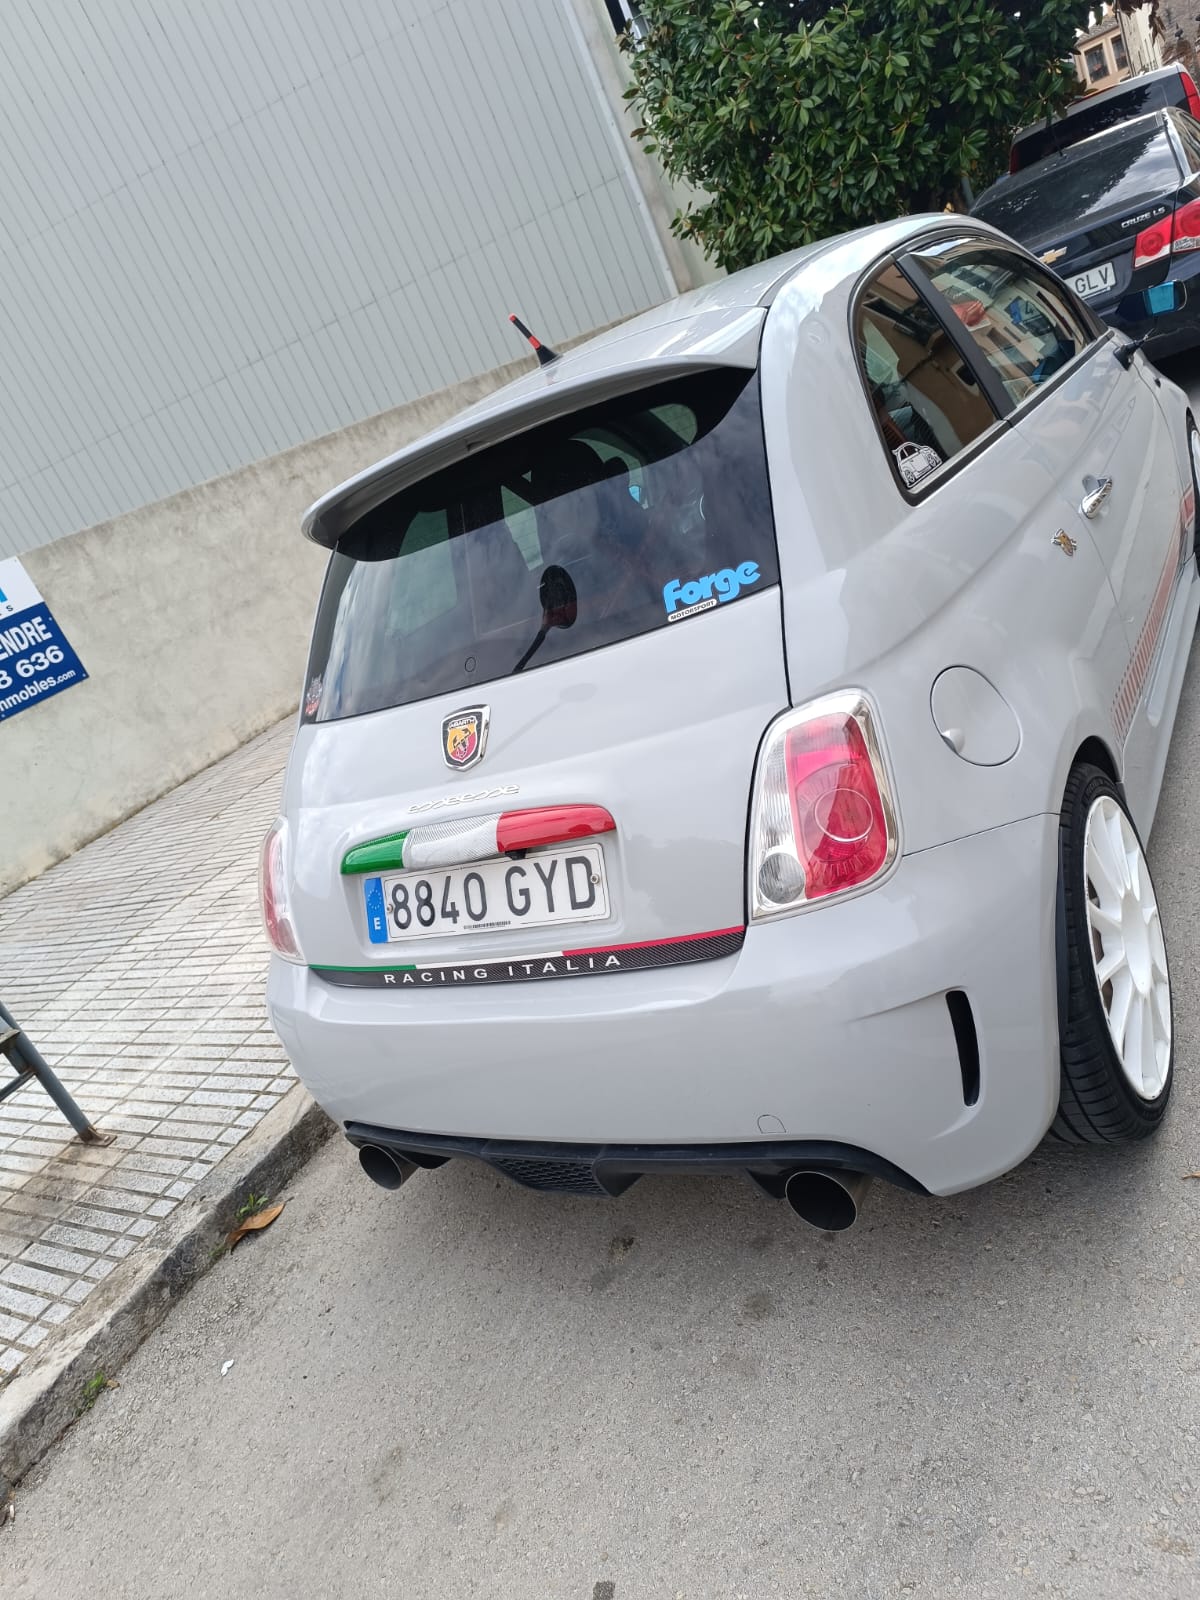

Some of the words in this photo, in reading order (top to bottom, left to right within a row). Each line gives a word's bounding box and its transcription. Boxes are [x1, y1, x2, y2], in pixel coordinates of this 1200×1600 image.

[1121, 212, 1151, 229] CRUZE
[1152, 206, 1166, 216] LS
[1075, 267, 1109, 293] GLV
[670, 600, 715, 620] MOTORSPORT
[16, 645, 64, 678] 636
[391, 872, 488, 930] 8840
[505, 856, 596, 916] GYD
[374, 917, 381, 930] E
[384, 968, 488, 985] RACING
[508, 955, 621, 976] ITALIA
